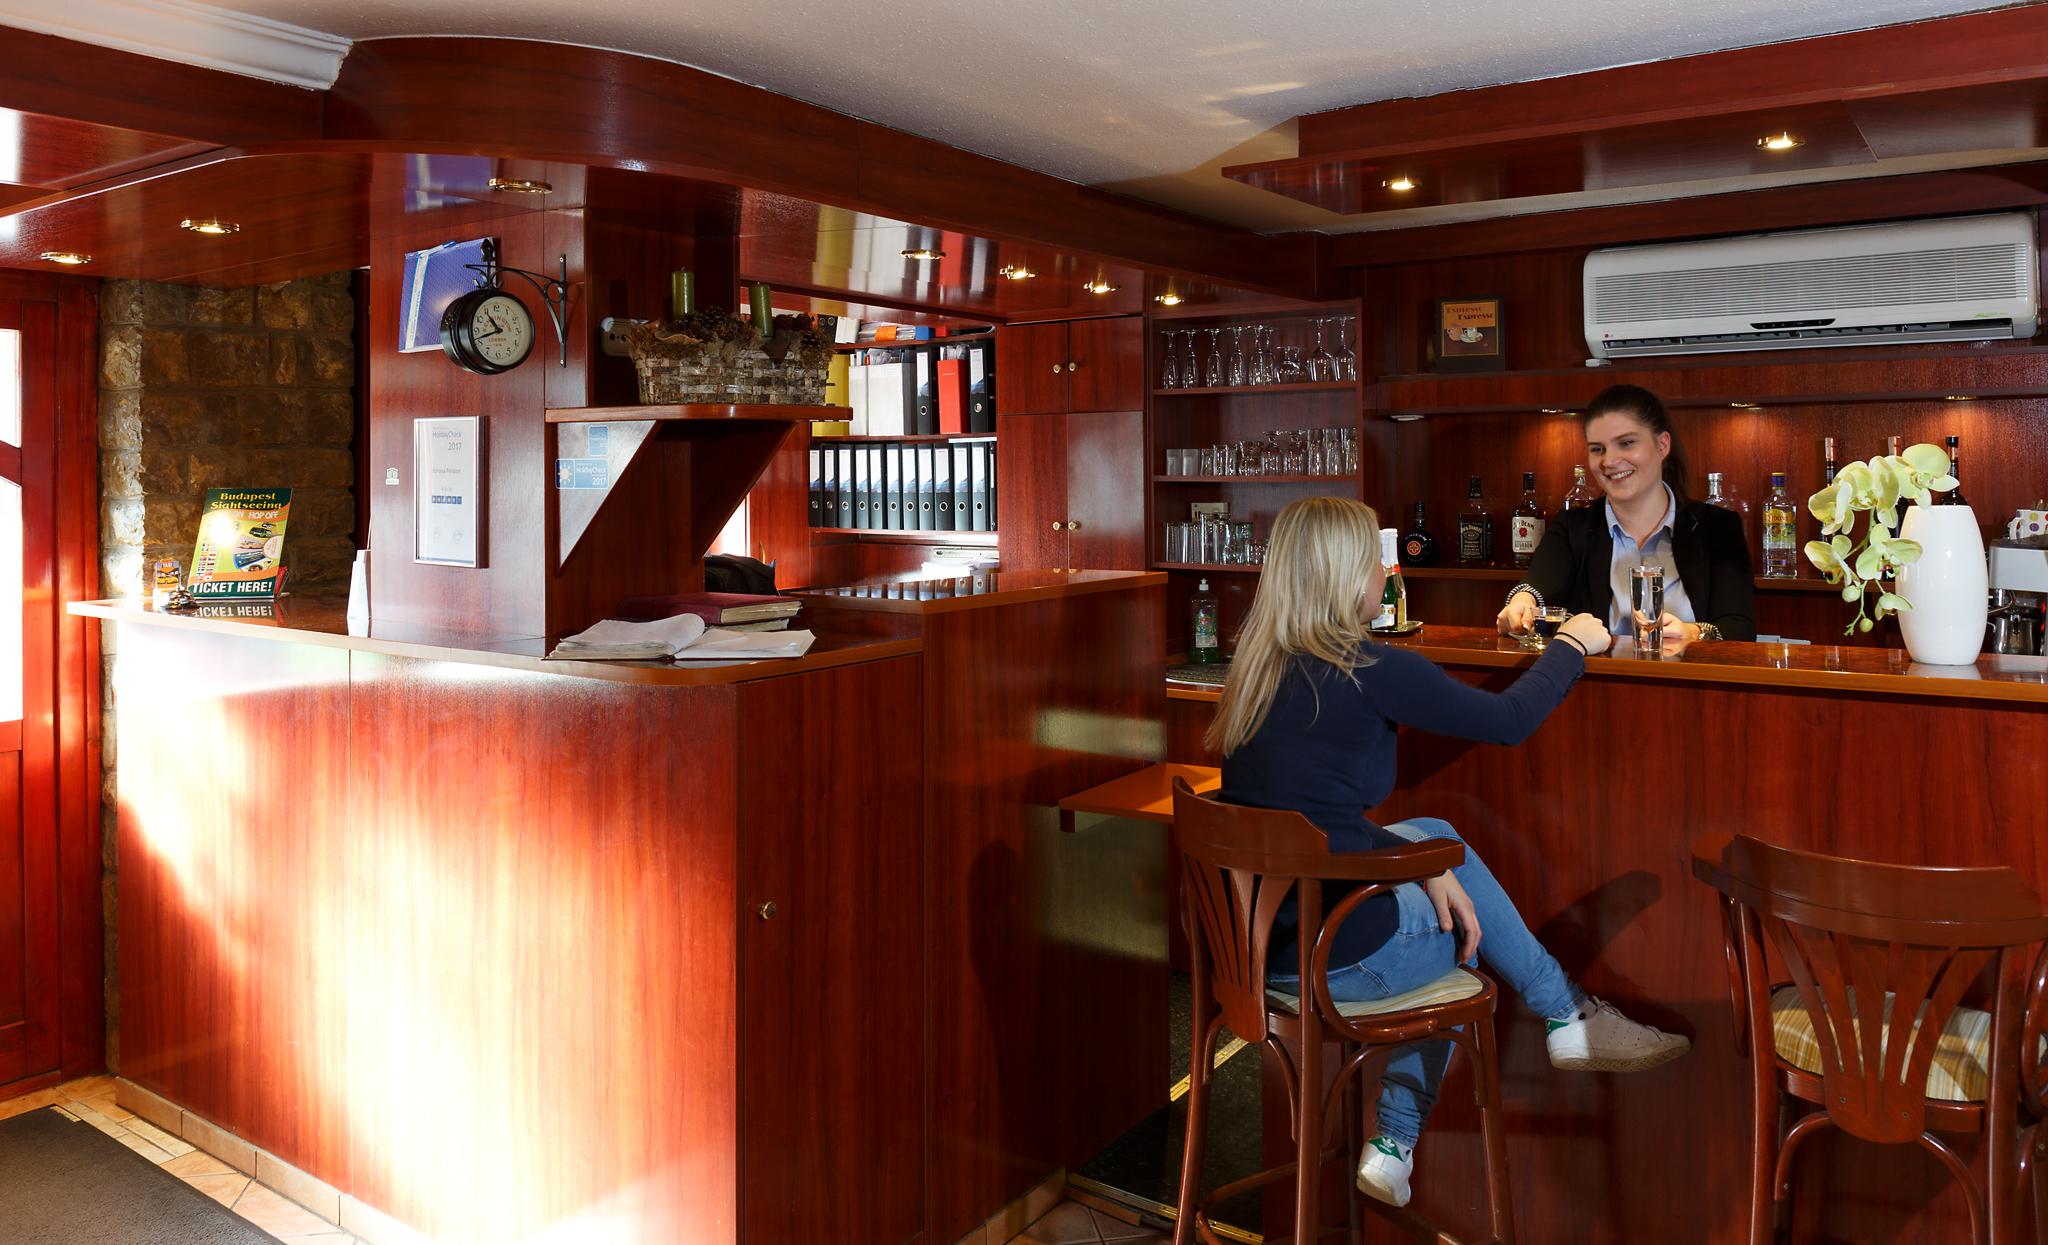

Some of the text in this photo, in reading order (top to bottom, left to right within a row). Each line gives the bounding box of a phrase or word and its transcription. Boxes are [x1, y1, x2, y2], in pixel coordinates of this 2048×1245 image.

[447, 442, 462, 451] 2017
[592, 477, 607, 485] 2017
[220, 492, 276, 502] Budapest
[210, 501, 282, 510] Sightseeing
[193, 581, 273, 593] TICKET HERE!
